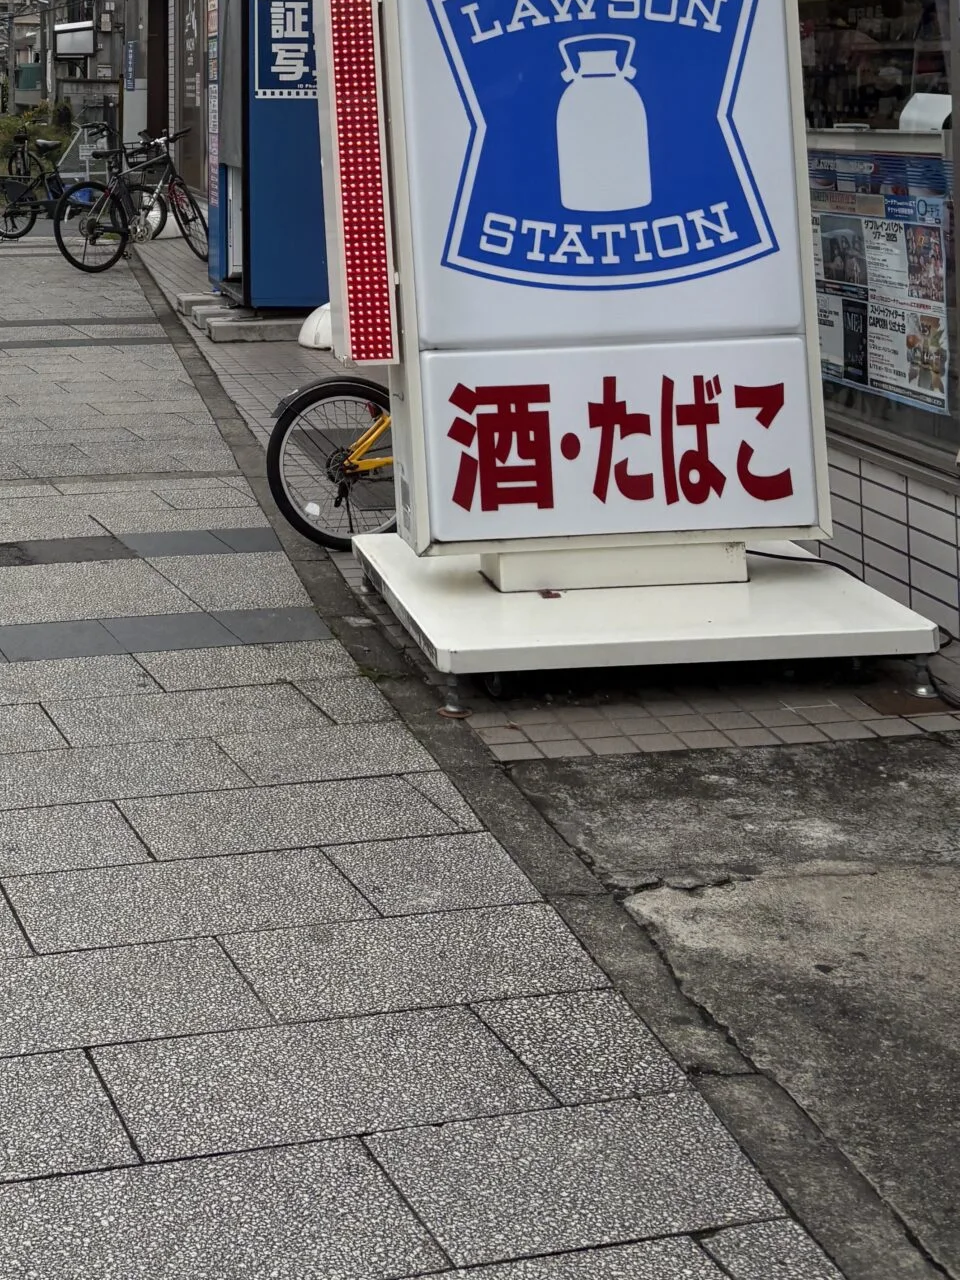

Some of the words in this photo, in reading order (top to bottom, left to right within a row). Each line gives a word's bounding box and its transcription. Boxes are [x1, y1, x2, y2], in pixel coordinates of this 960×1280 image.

[270, 1, 309, 38] 証
[270, 43, 317, 81] 写
[480, 201, 739, 265] STATION
[447, 373, 794, 512] 酒・たばこ
